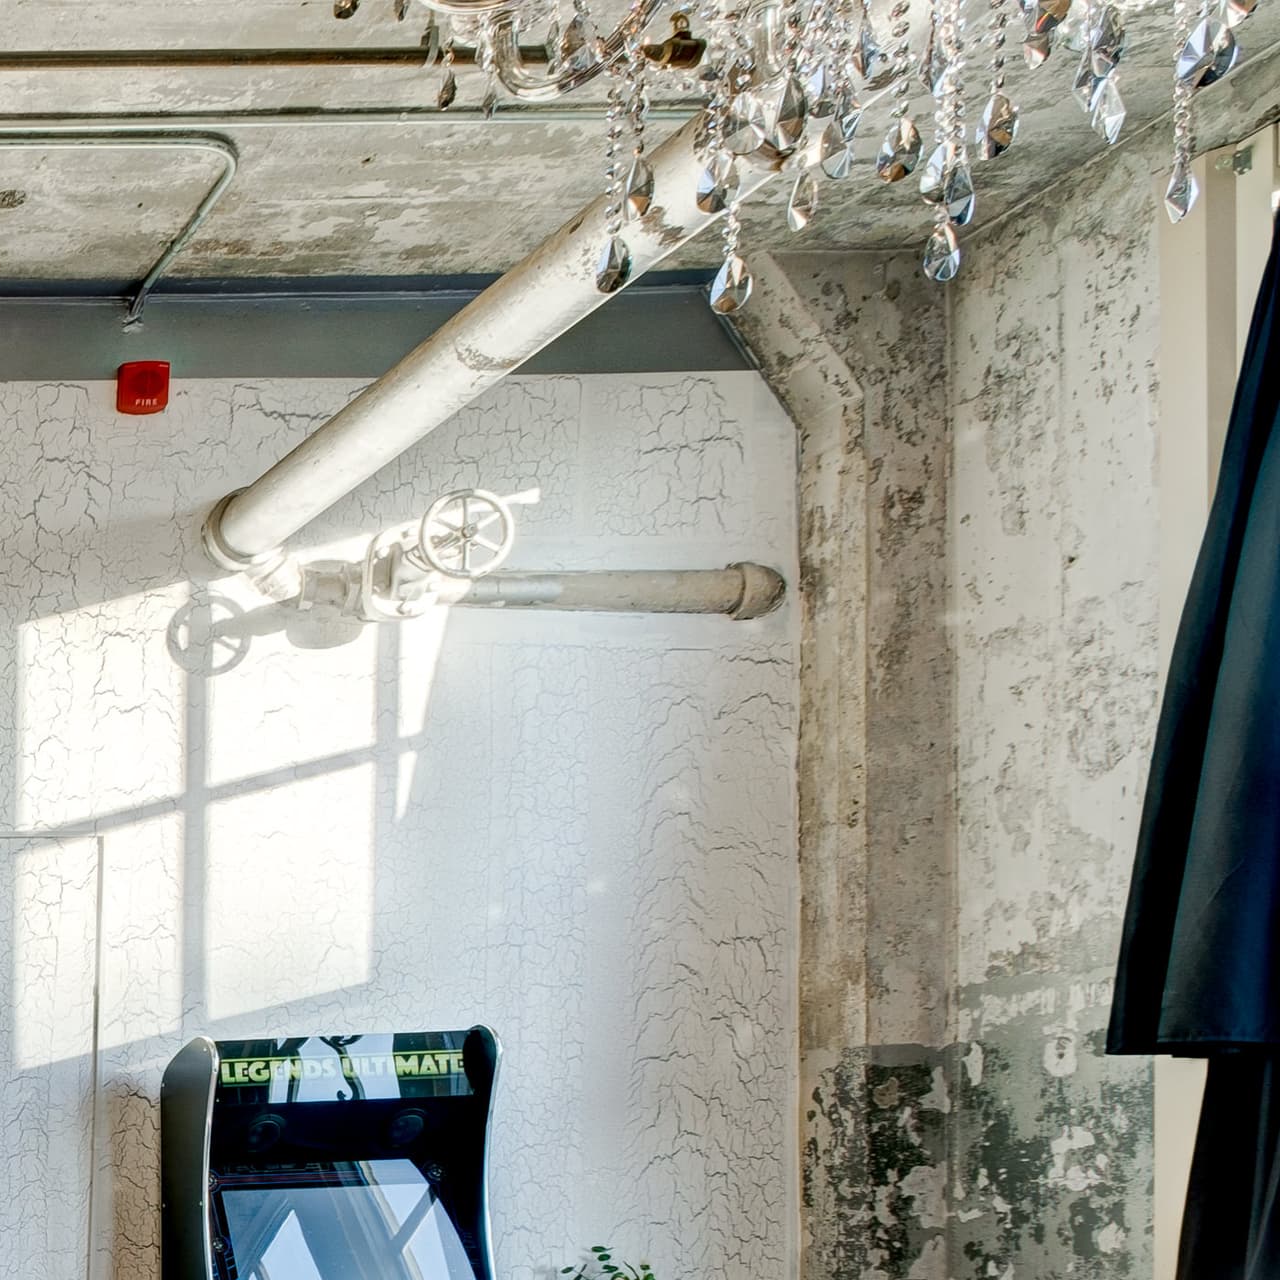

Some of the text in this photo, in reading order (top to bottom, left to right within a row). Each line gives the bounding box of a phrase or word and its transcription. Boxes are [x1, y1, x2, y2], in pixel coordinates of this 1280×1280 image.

[135, 398, 158, 406] FIRE
[220, 1053, 464, 1084] LEGENDS ULTIMATE
